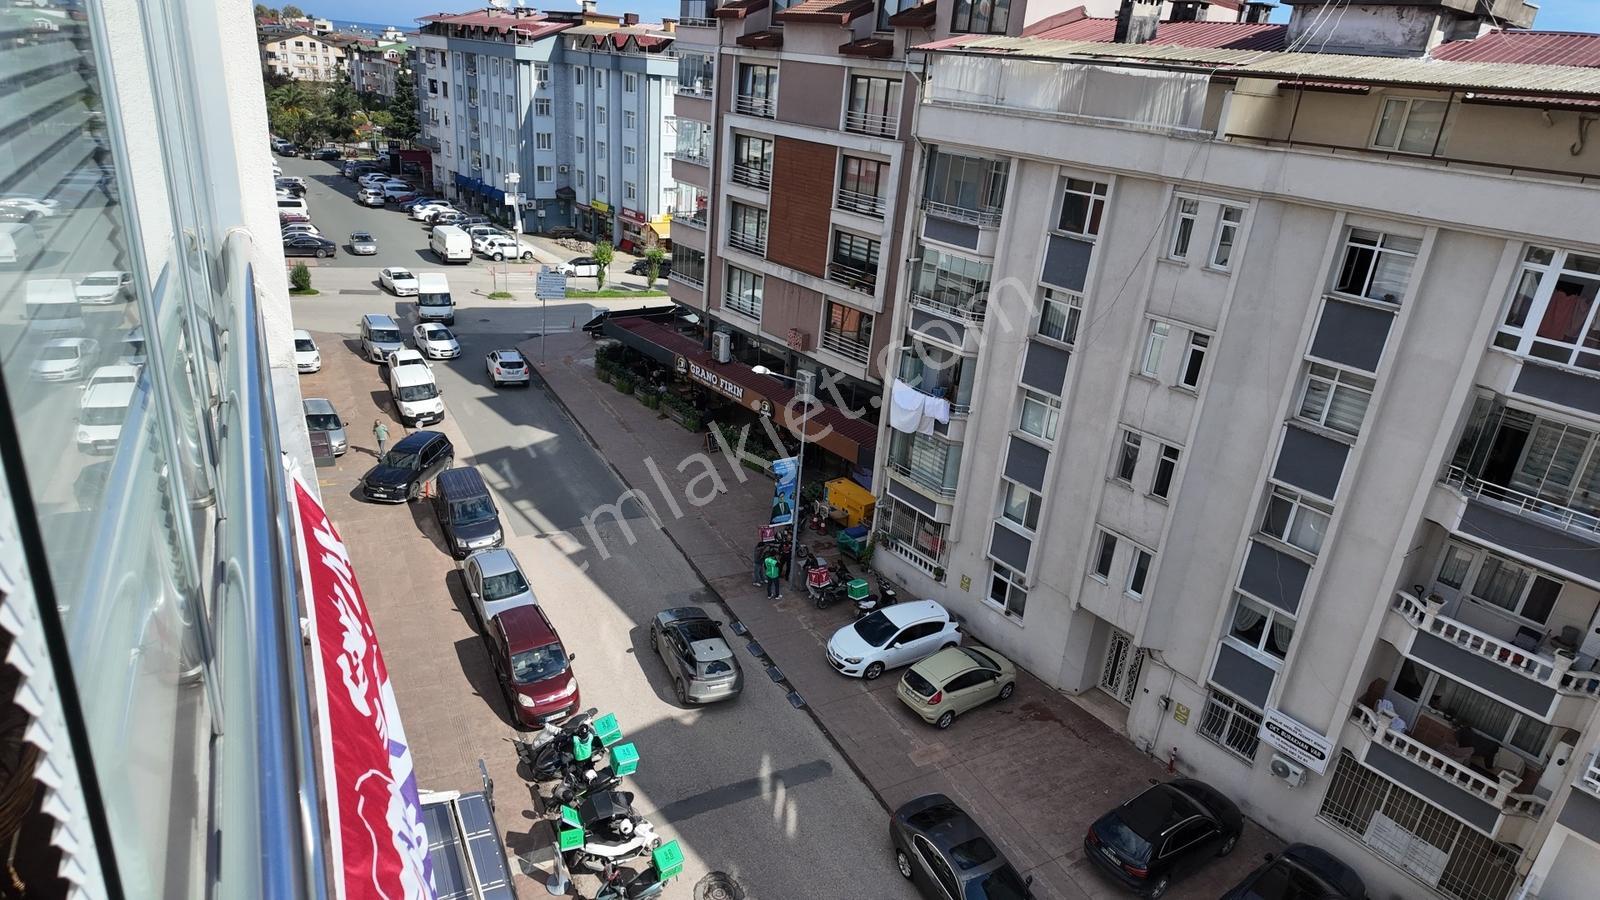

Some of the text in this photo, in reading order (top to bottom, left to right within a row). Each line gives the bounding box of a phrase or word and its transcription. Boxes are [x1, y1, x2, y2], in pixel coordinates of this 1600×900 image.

[689, 362, 718, 386] GRANO
[720, 378, 744, 399] FIRIN
[1280, 730, 1309, 751] BURAKHAN
[1310, 748, 1322, 758] VAR
